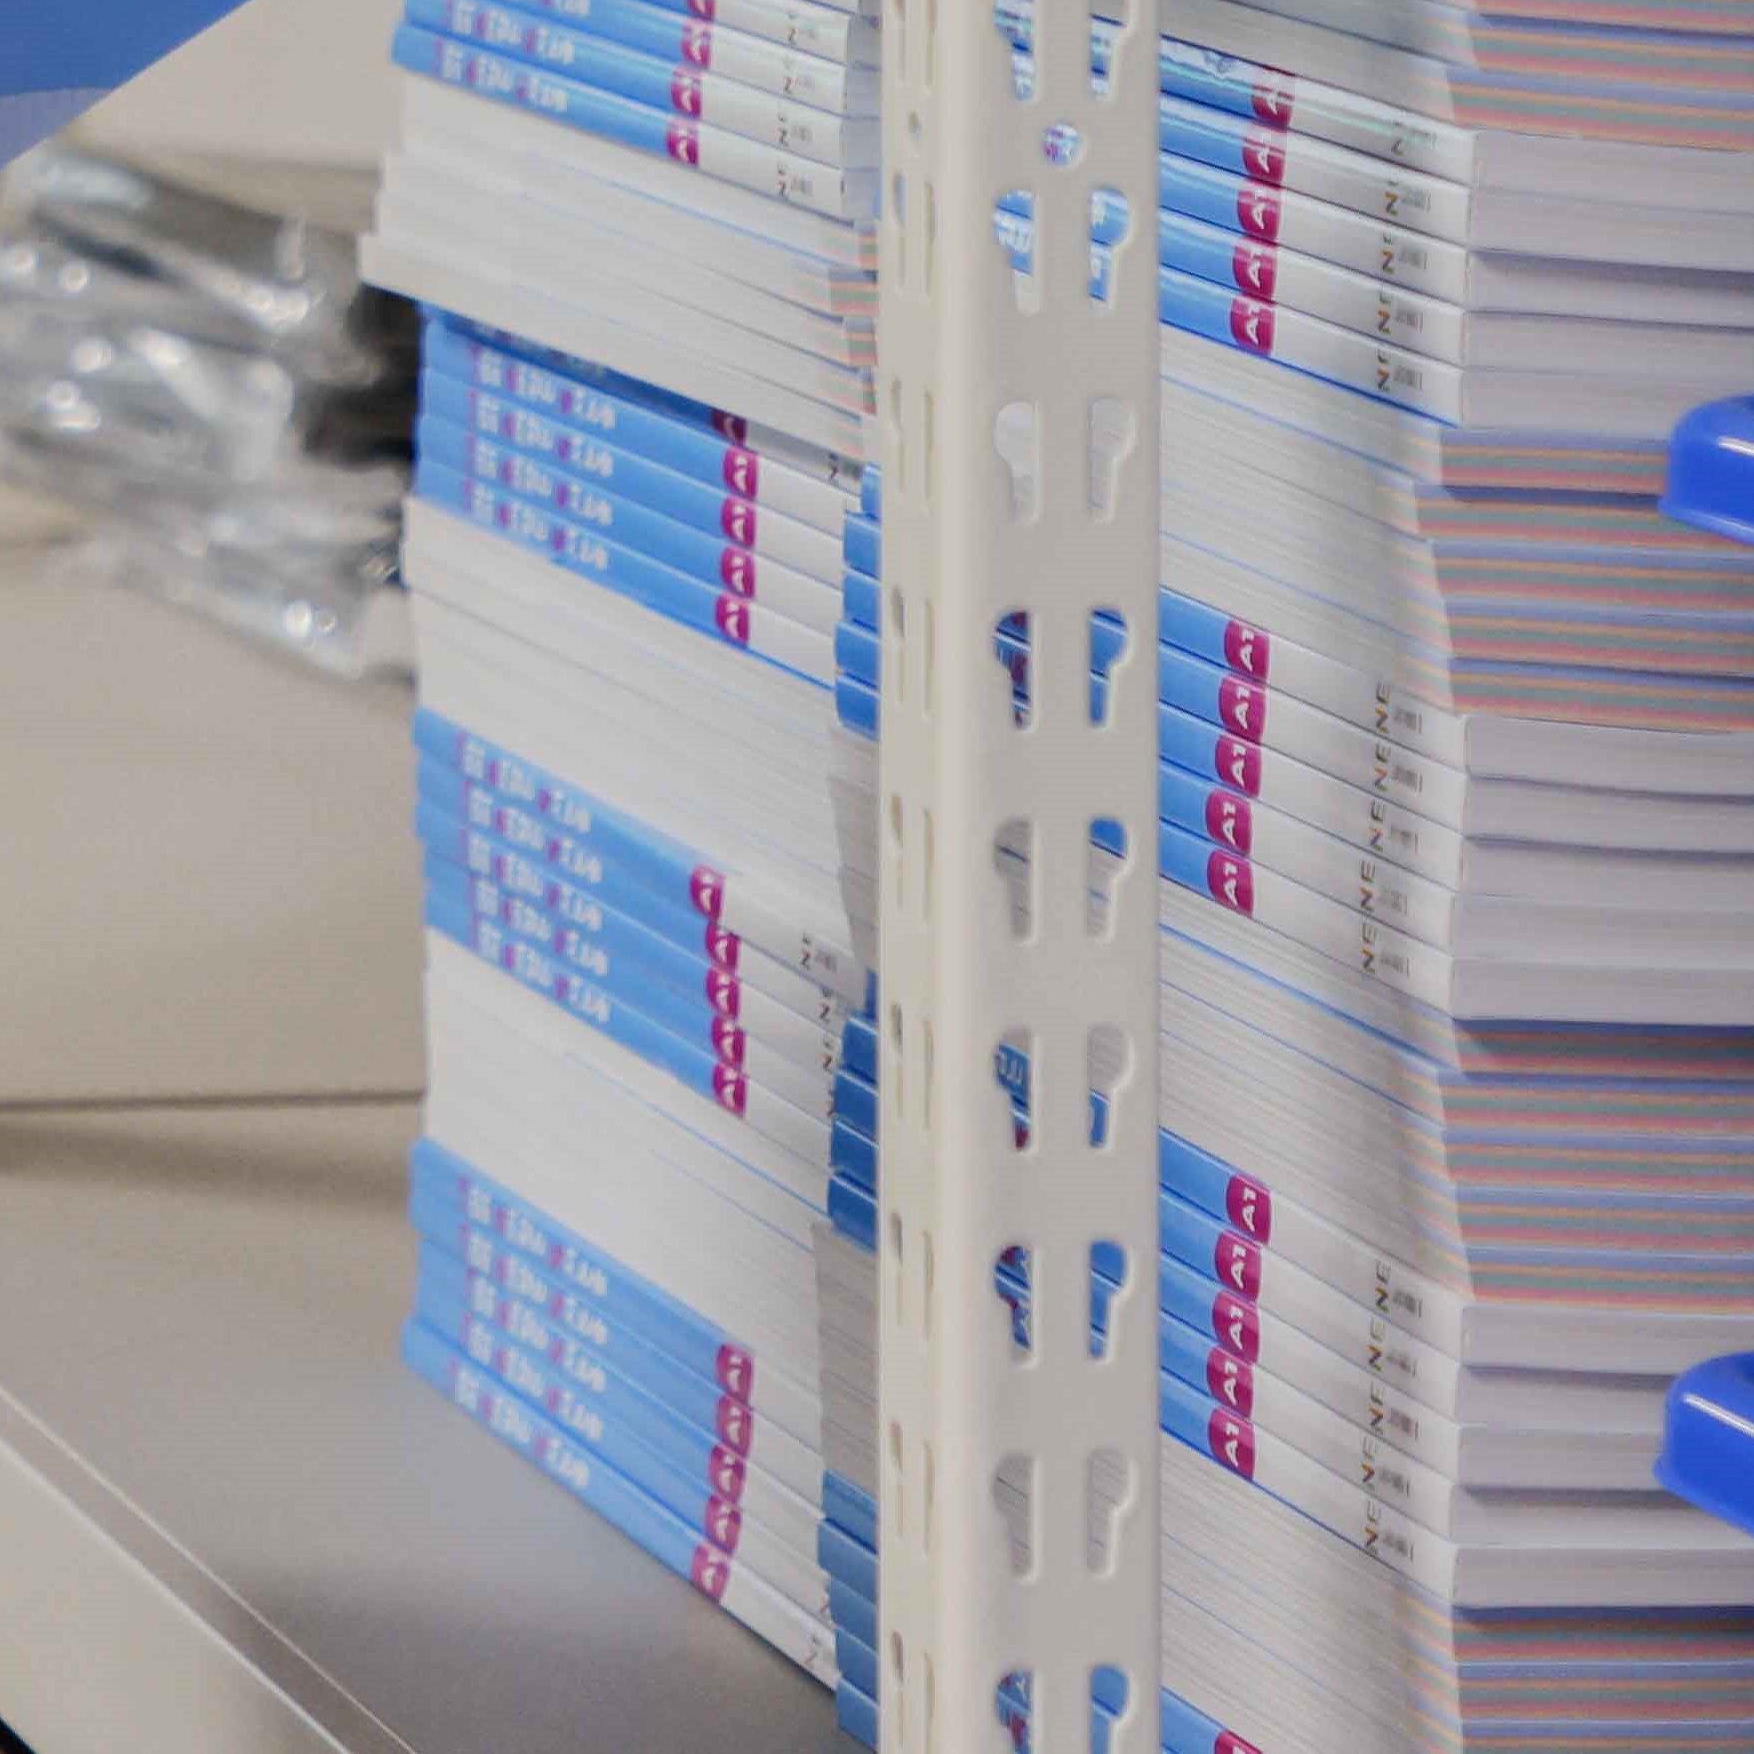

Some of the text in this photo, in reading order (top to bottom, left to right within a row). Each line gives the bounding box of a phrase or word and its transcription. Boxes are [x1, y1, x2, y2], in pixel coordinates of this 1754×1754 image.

[1239, 629, 1254, 671] A1
[1234, 686, 1251, 729] A1
[1230, 744, 1247, 786] A1
[1221, 801, 1237, 843] A1
[1223, 863, 1238, 905] A1
[1242, 1187, 1256, 1230] A1
[1231, 1247, 1246, 1290] A1
[1228, 1306, 1244, 1348] A1
[1223, 1363, 1238, 1405] A1
[1224, 1420, 1239, 1461] A1
